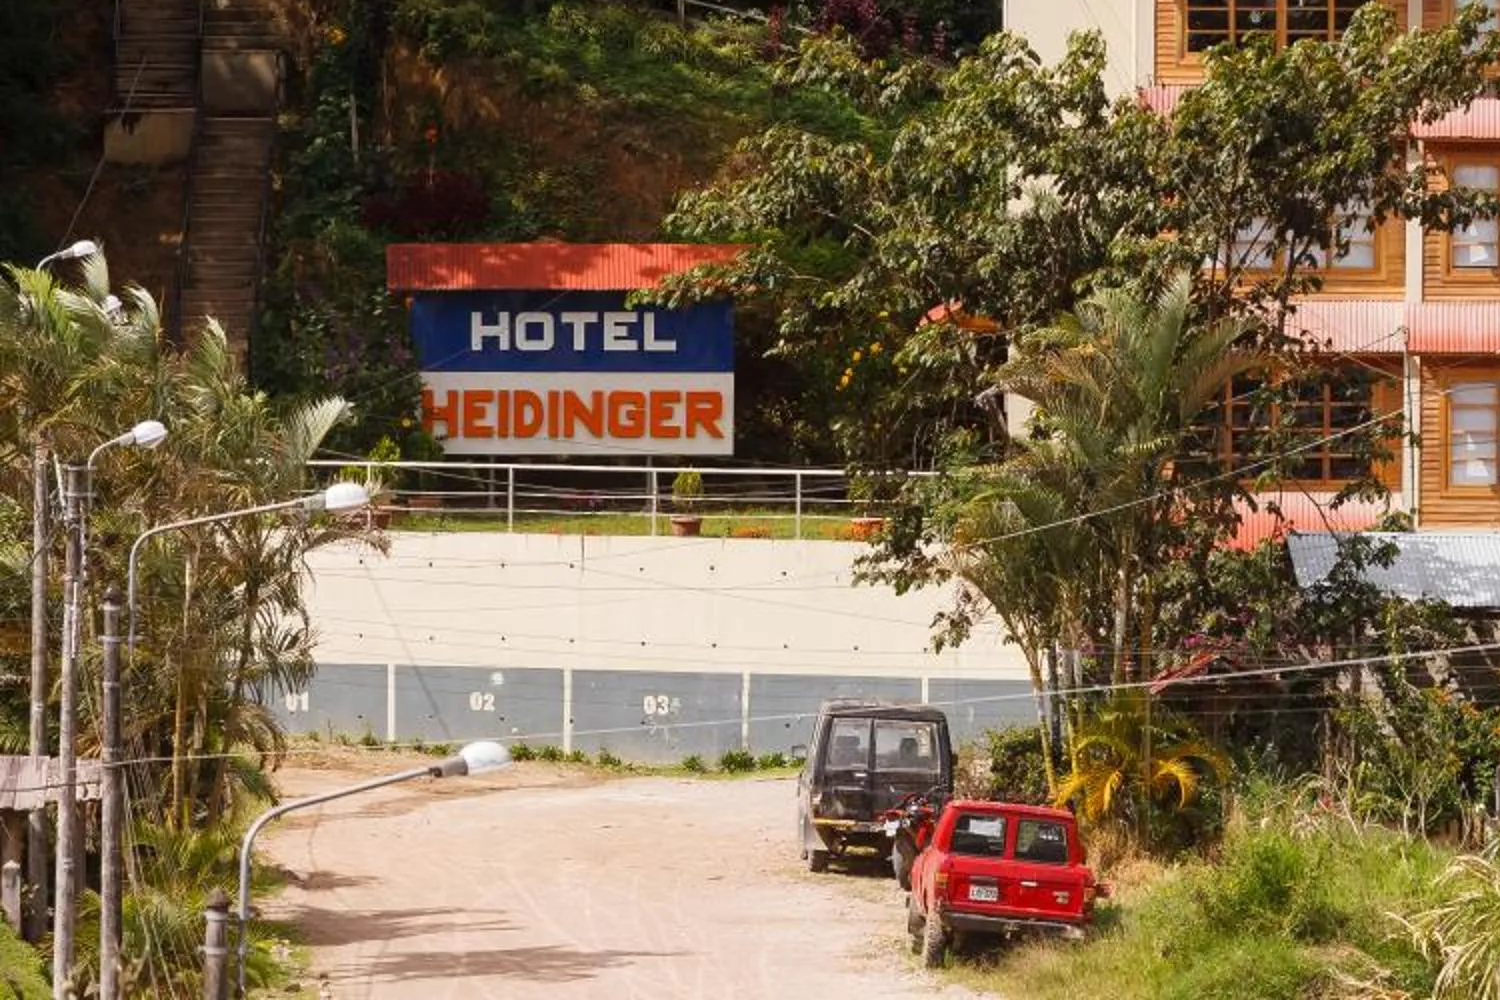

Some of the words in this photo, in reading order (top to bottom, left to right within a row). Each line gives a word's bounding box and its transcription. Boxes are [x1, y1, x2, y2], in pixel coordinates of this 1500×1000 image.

[470, 311, 677, 351] HOTEL
[422, 389, 725, 439] HEIDINGER
[286, 691, 309, 712] 01
[470, 691, 496, 712] 02
[643, 695, 669, 715] 03
